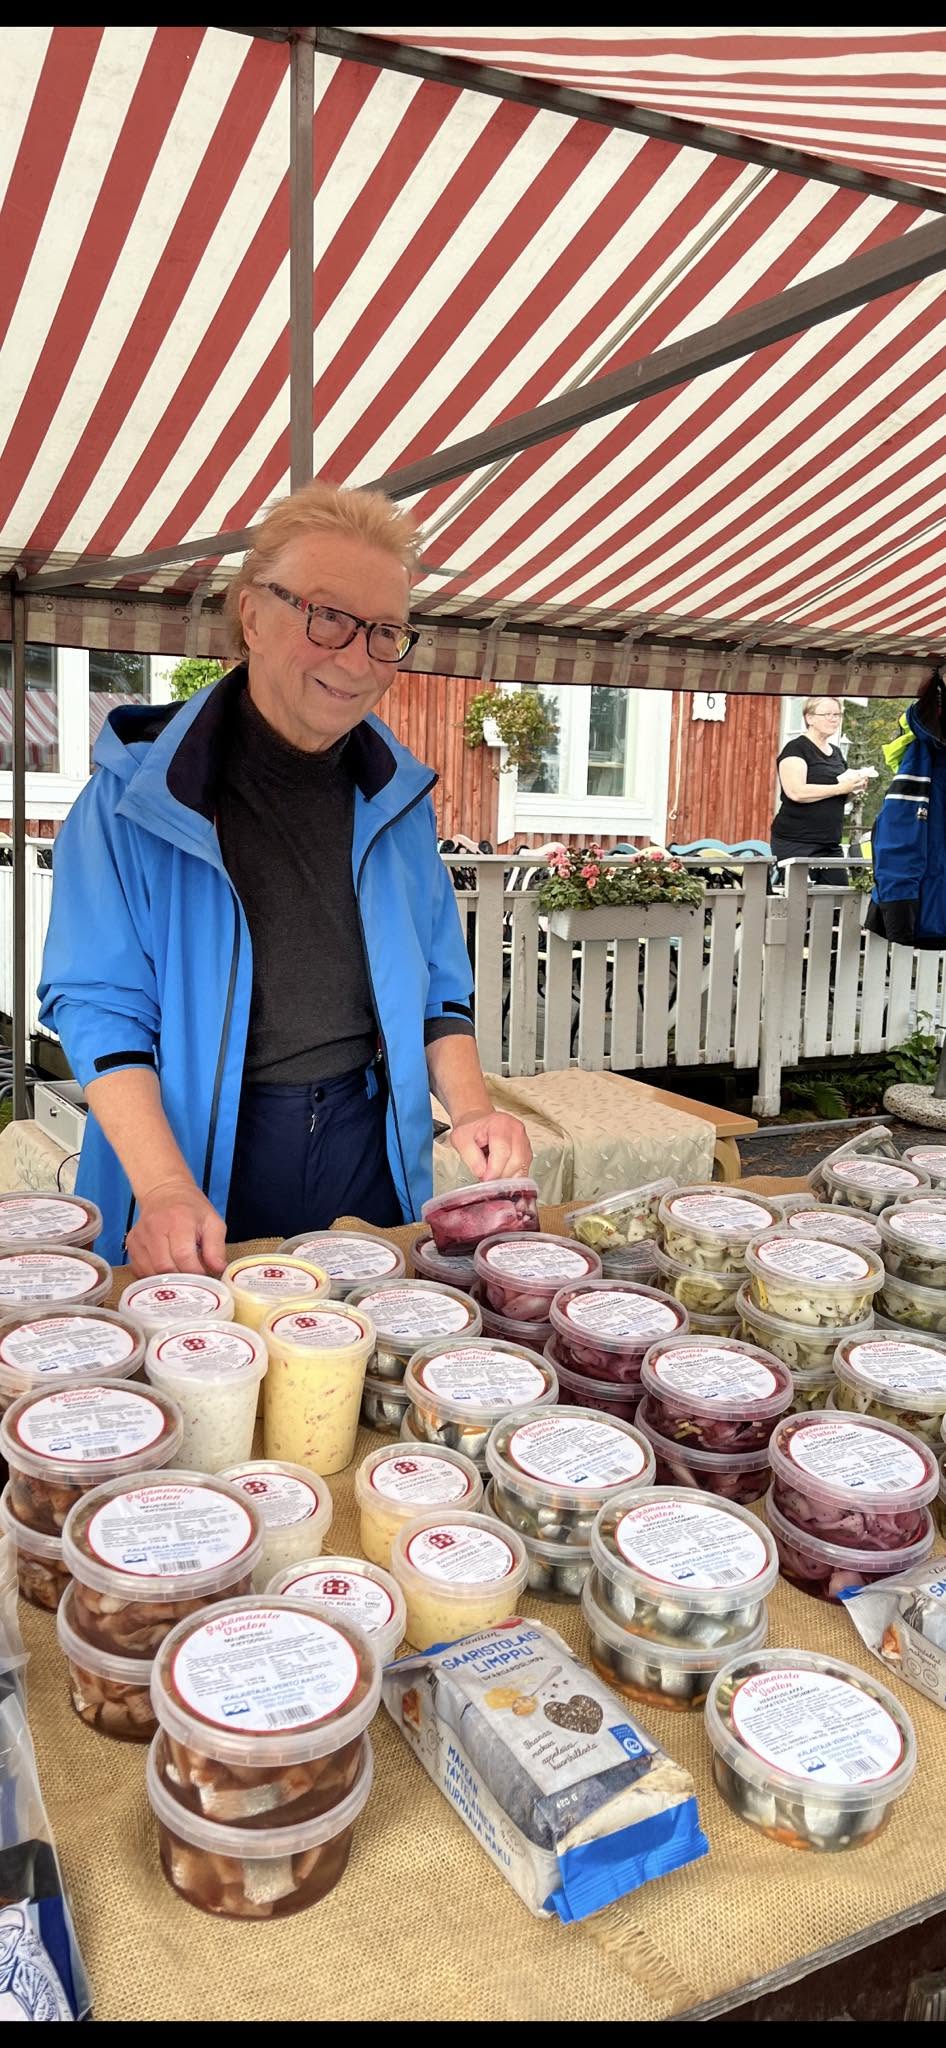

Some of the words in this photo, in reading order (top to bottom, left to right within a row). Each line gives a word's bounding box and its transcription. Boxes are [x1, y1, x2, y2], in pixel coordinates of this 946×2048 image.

[706, 692, 716, 710] 6
[441, 1631, 542, 1671] SAARISTOLAIS
[472, 1646, 534, 1674] LIMPPU
[447, 1744, 479, 1799] MAKEAN
[444, 1776, 483, 1838] HURMAAVA
[484, 1831, 512, 1867] MAKU
